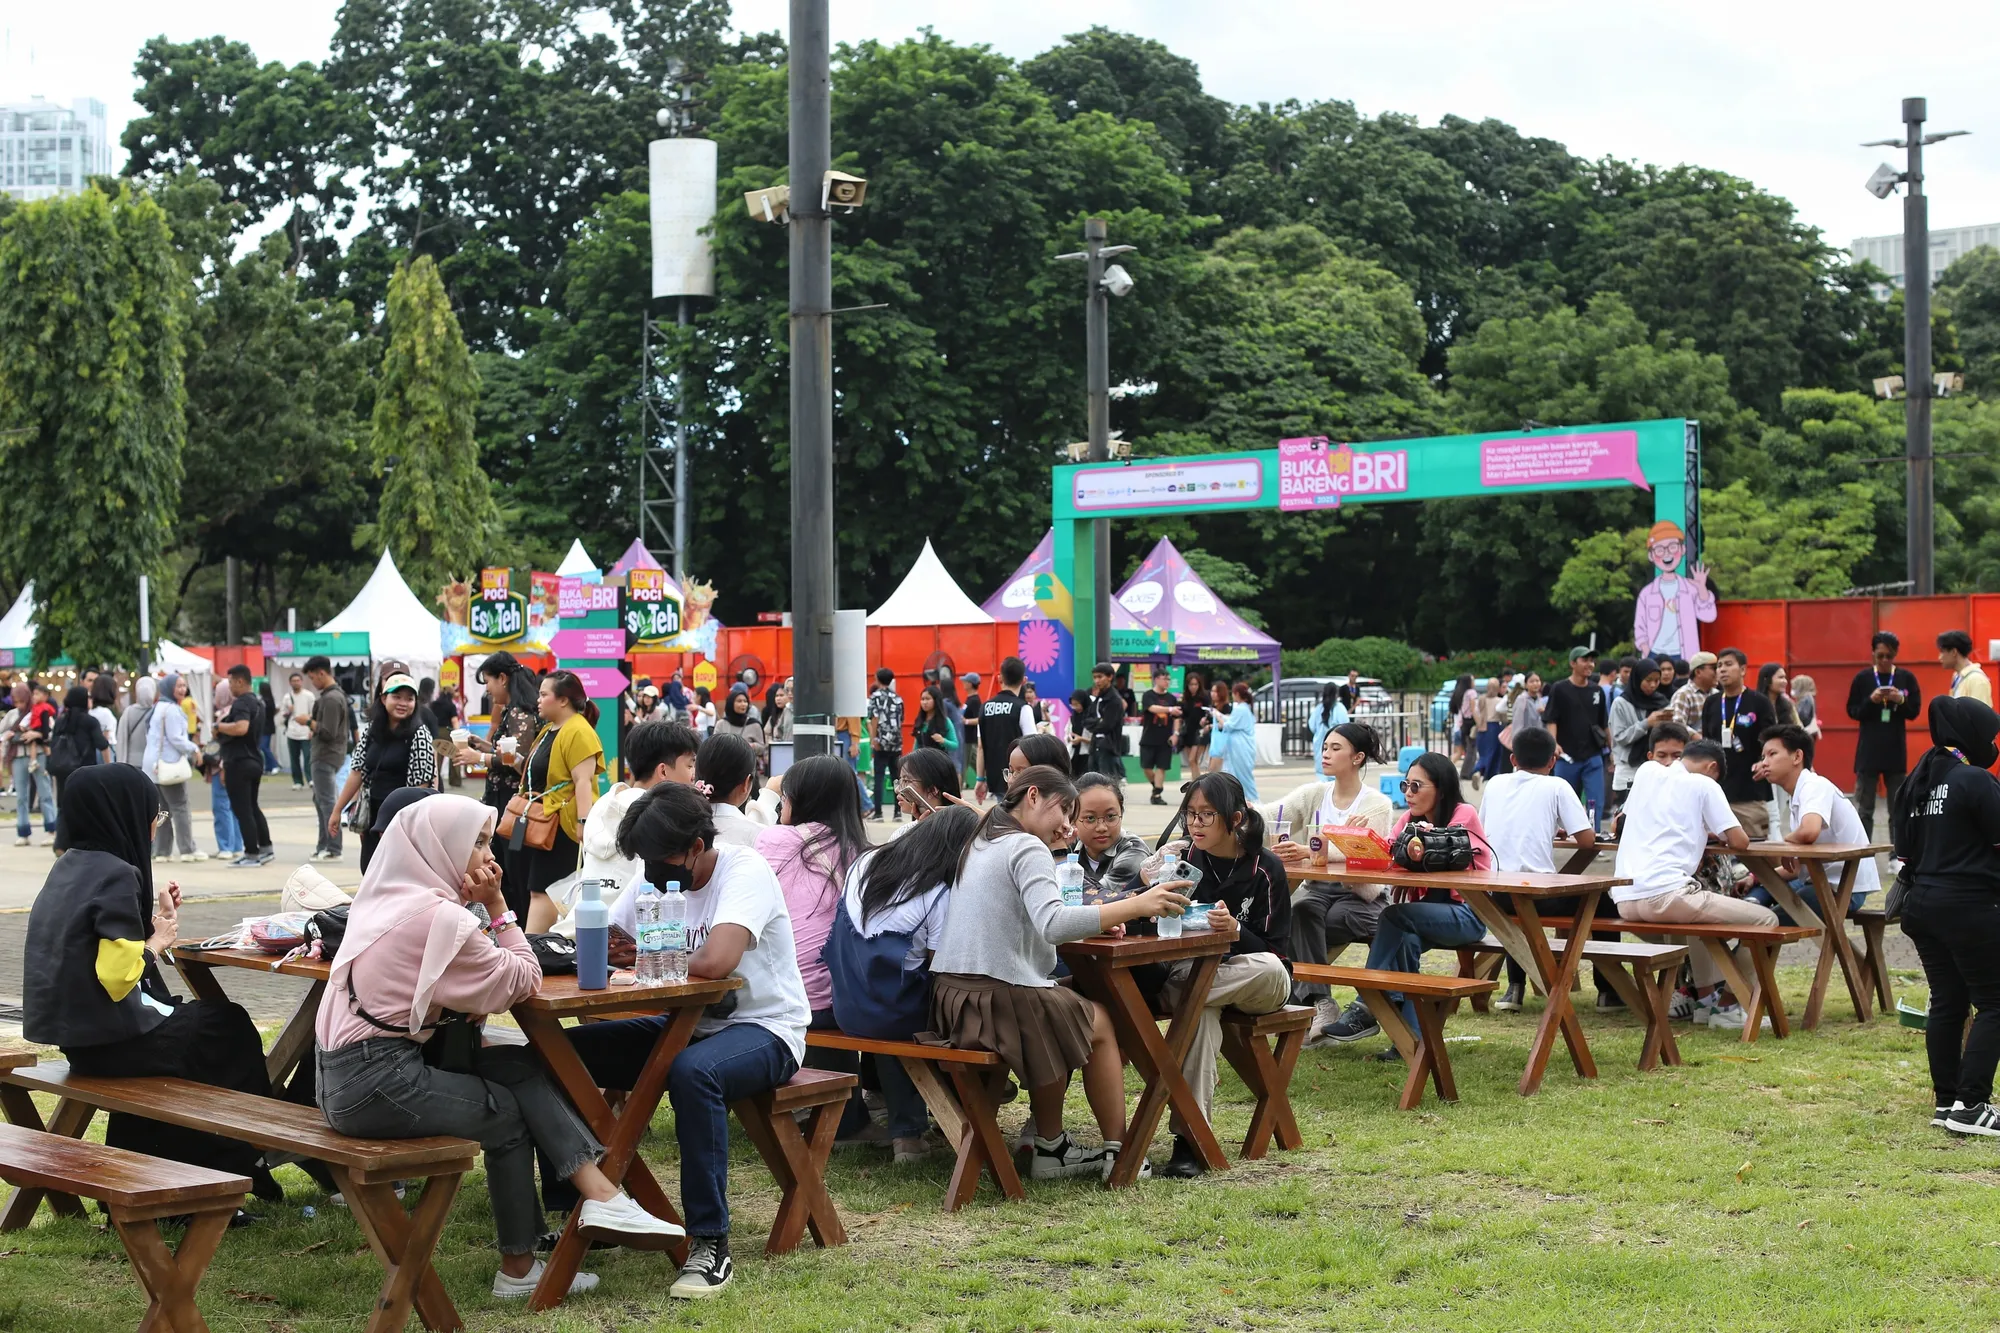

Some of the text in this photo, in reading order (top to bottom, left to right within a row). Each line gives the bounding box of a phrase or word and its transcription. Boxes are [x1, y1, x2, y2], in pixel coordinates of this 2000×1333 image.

[1280, 441, 1327, 456] Kapanlgi
[1281, 459, 1328, 477] BUKA
[1352, 453, 1405, 492] BRI
[1281, 475, 1350, 494] BARENG
[1281, 497, 1313, 506] FESTIVAL
[484, 588, 508, 601] POCI
[560, 589, 582, 599] BUKA
[593, 587, 618, 608] BRI
[633, 588, 662, 601] POCI
[560, 598, 592, 609] BARENG
[471, 602, 521, 634] Es Teh
[625, 603, 678, 635] s Teh
[1110, 638, 1124, 646] OST
[1131, 638, 1156, 647] FOUND
[995, 702, 1013, 715] BRI
